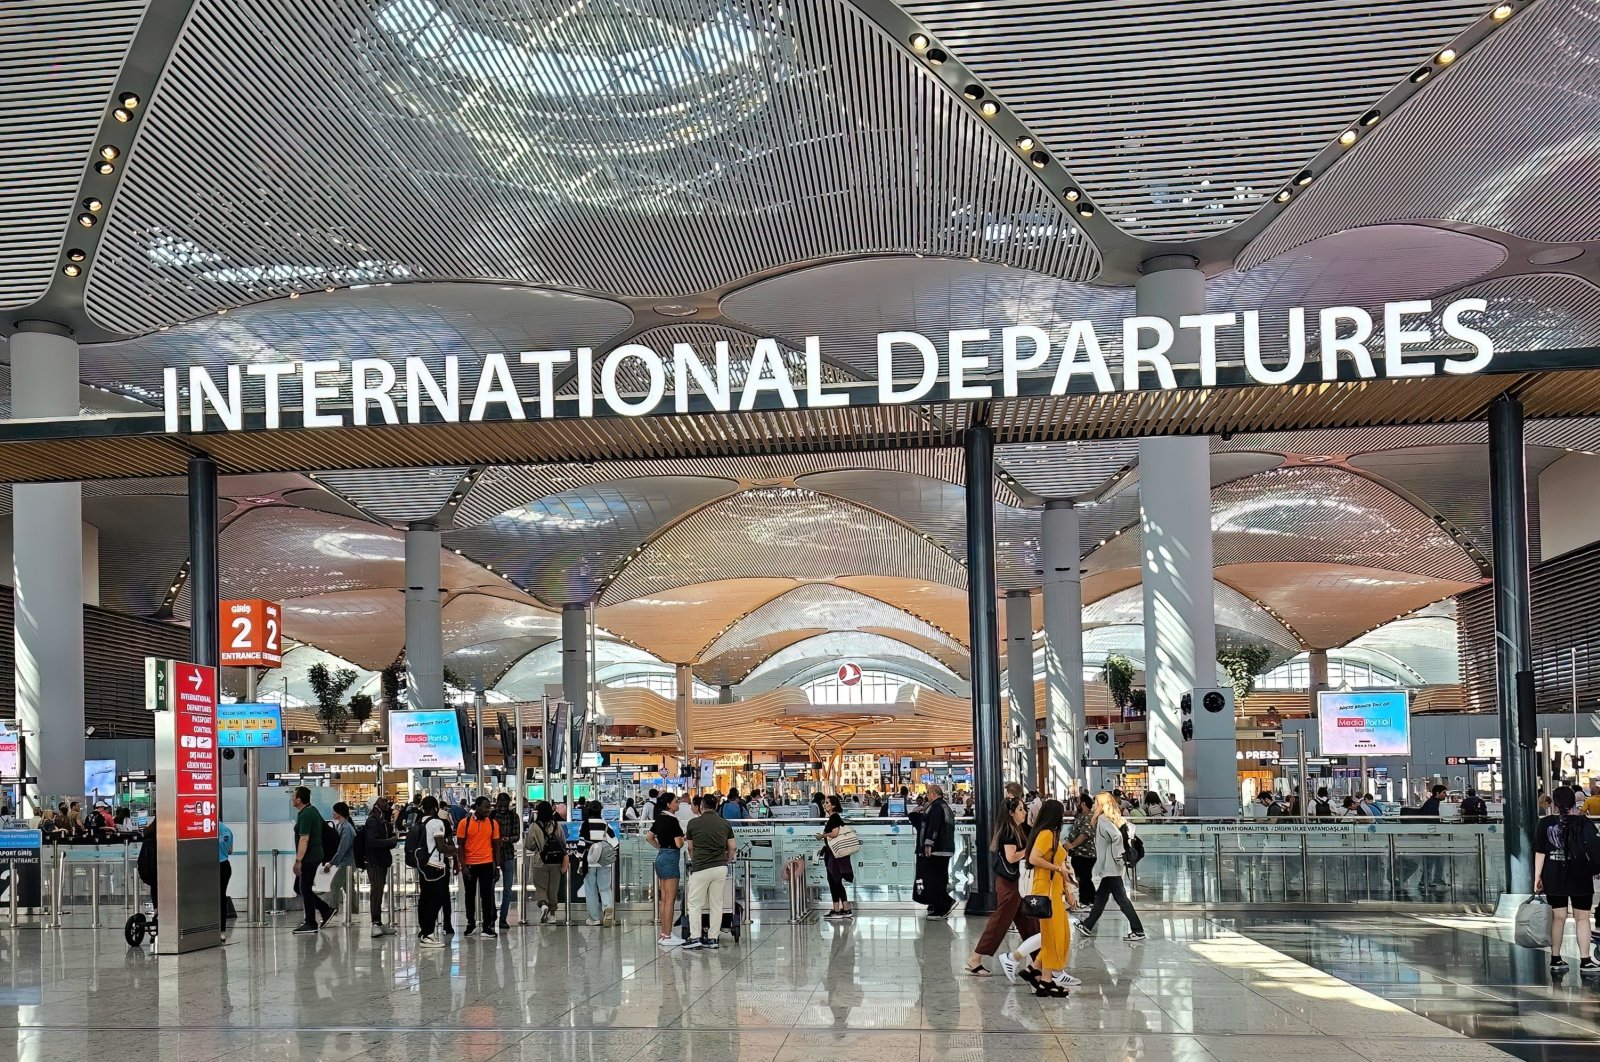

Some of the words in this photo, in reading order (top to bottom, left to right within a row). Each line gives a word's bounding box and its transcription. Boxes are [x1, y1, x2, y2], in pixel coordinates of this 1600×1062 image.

[163, 335, 850, 433] INTERNATIONAL
[877, 298, 1494, 404] DEPARTURES
[231, 617, 252, 648] 2
[266, 619, 278, 651] 2
[221, 652, 261, 660] ENTRANCE
[1246, 751, 1279, 760] PRESS
